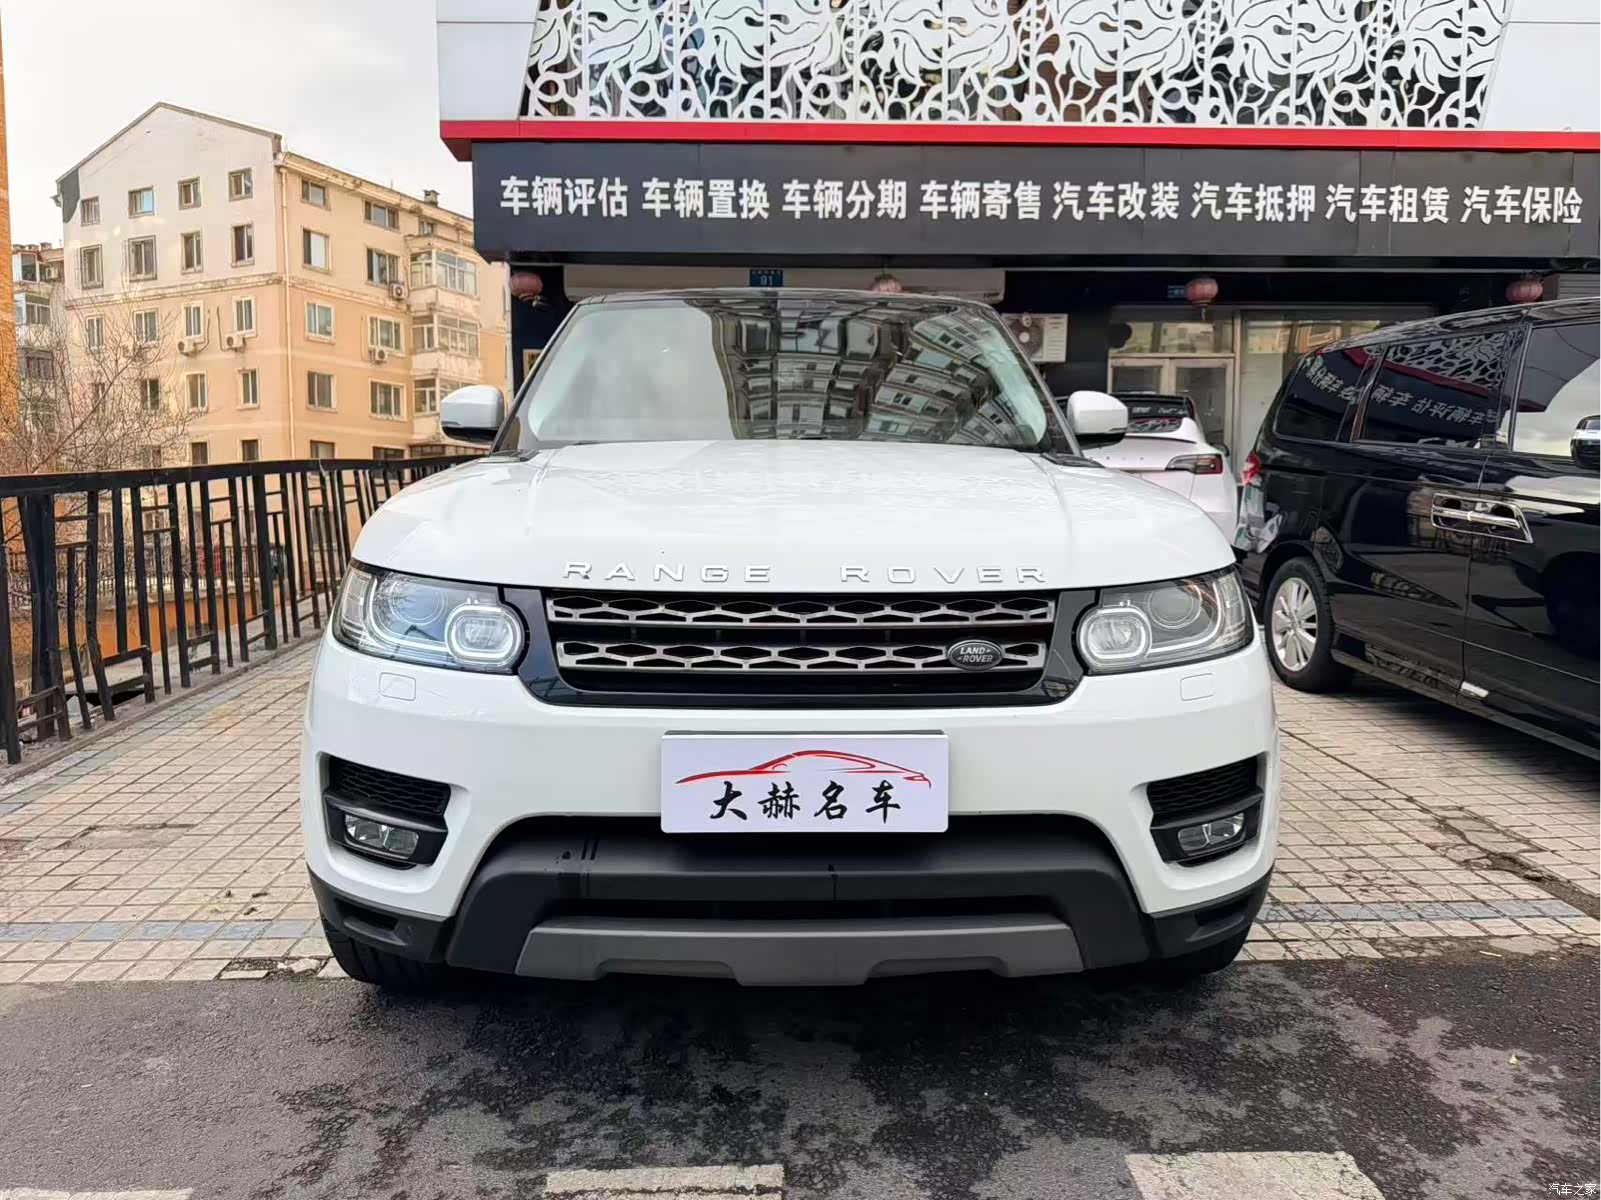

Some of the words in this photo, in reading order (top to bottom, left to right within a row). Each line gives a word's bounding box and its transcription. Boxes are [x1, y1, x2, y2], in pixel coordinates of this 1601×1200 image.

[500, 175, 628, 217] 车辆评估
[642, 177, 770, 219] 车辆置换
[782, 178, 907, 219] 车辆分期
[919, 179, 1042, 220] 车辆寄售
[1052, 180, 1180, 220] 汽车改装
[1191, 181, 1316, 222] 汽车抵押
[1324, 183, 1450, 224] 汽车租赁
[1460, 184, 1583, 225] 汽车保险
[760, 275, 773, 286] 91
[563, 561, 771, 583] RANGE
[840, 565, 1046, 584] ROVER
[709, 780, 901, 824] 大赫名车
